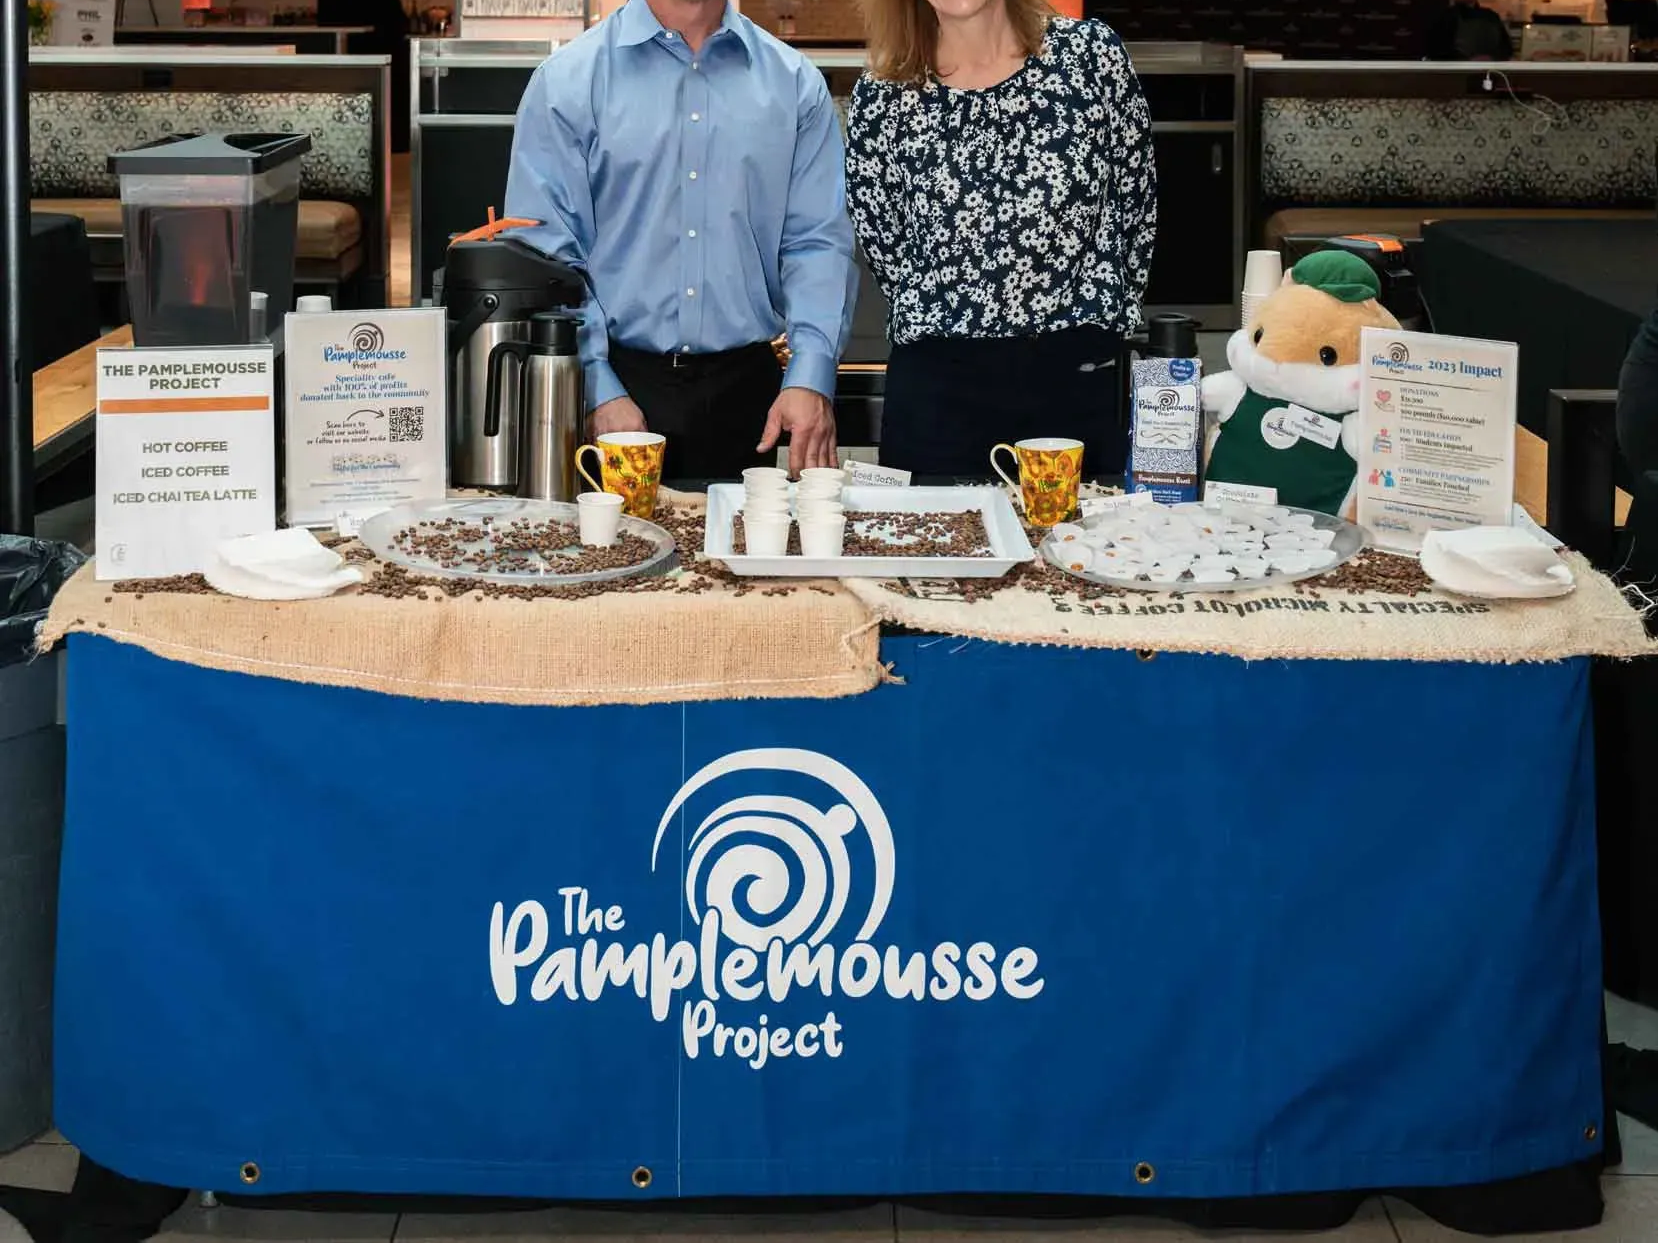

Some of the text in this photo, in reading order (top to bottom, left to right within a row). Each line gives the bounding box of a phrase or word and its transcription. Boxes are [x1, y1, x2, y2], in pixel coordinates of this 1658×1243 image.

[323, 346, 407, 363] Pamplemousse
[102, 362, 267, 377] THE PAMPLEMOUSSE
[1428, 359, 1456, 374] 2023
[1459, 360, 1504, 379] Impact
[149, 377, 221, 390] PROJECT
[1138, 399, 1195, 413] Pamplemousse
[142, 441, 228, 454] HOT COFFEE
[141, 465, 230, 478] ICED COFFEE
[113, 489, 257, 505] ICED CHAI TEA LATTE
[1193, 597, 1330, 618] MICROLOT
[1338, 600, 1491, 615] SPECIALTY
[558, 886, 625, 937] The
[489, 899, 1045, 1022] Pamplemousse
[683, 999, 844, 1070] Project
